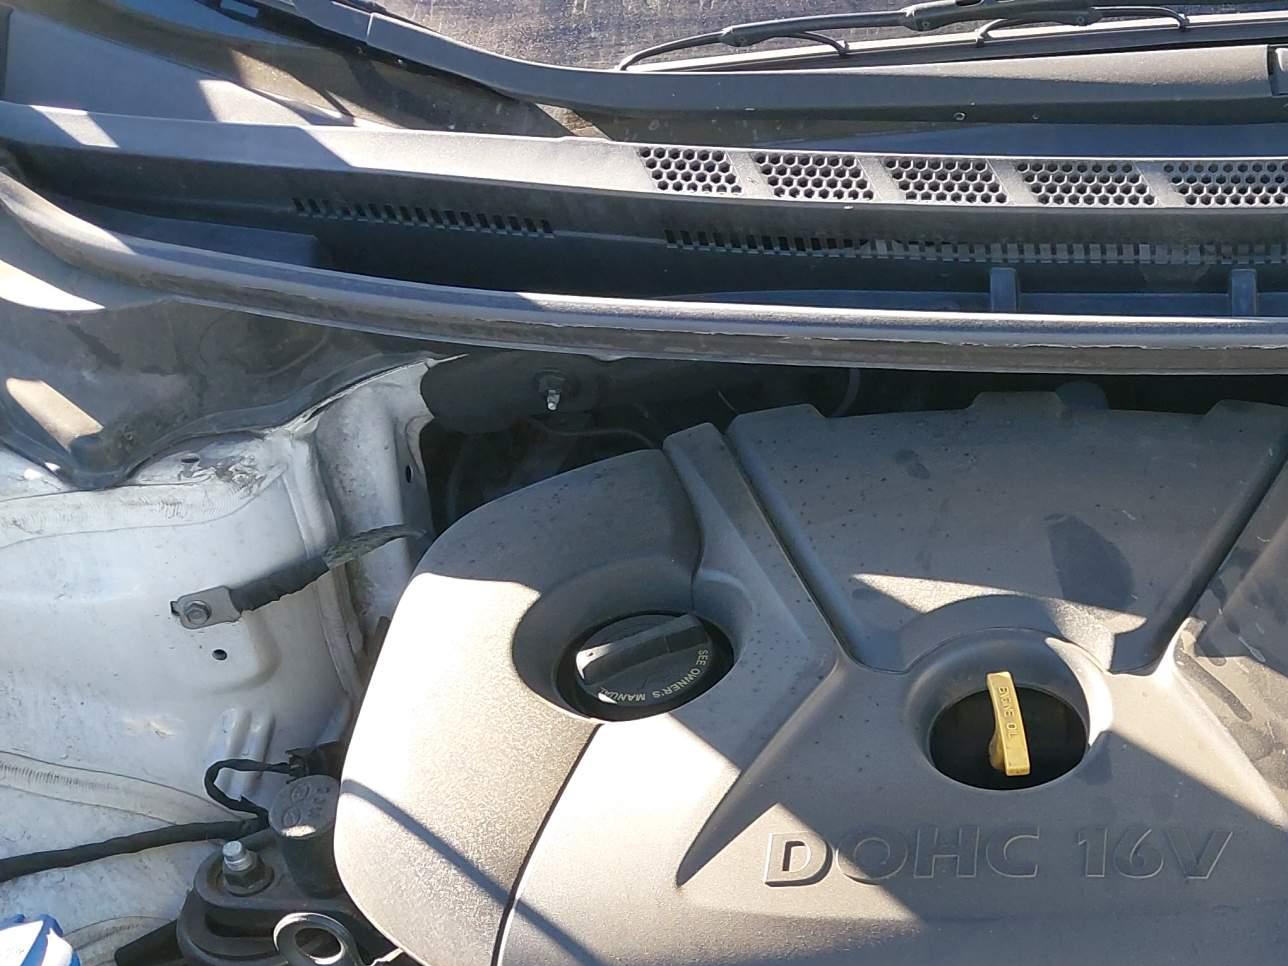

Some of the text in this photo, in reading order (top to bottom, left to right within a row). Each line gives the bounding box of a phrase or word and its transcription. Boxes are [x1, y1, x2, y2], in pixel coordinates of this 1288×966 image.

[696, 649, 708, 666] SEE
[652, 667, 702, 699] OWNER'S
[999, 686, 1018, 739] ENGINE OIL
[763, 825, 1233, 888] DOHC 16V
